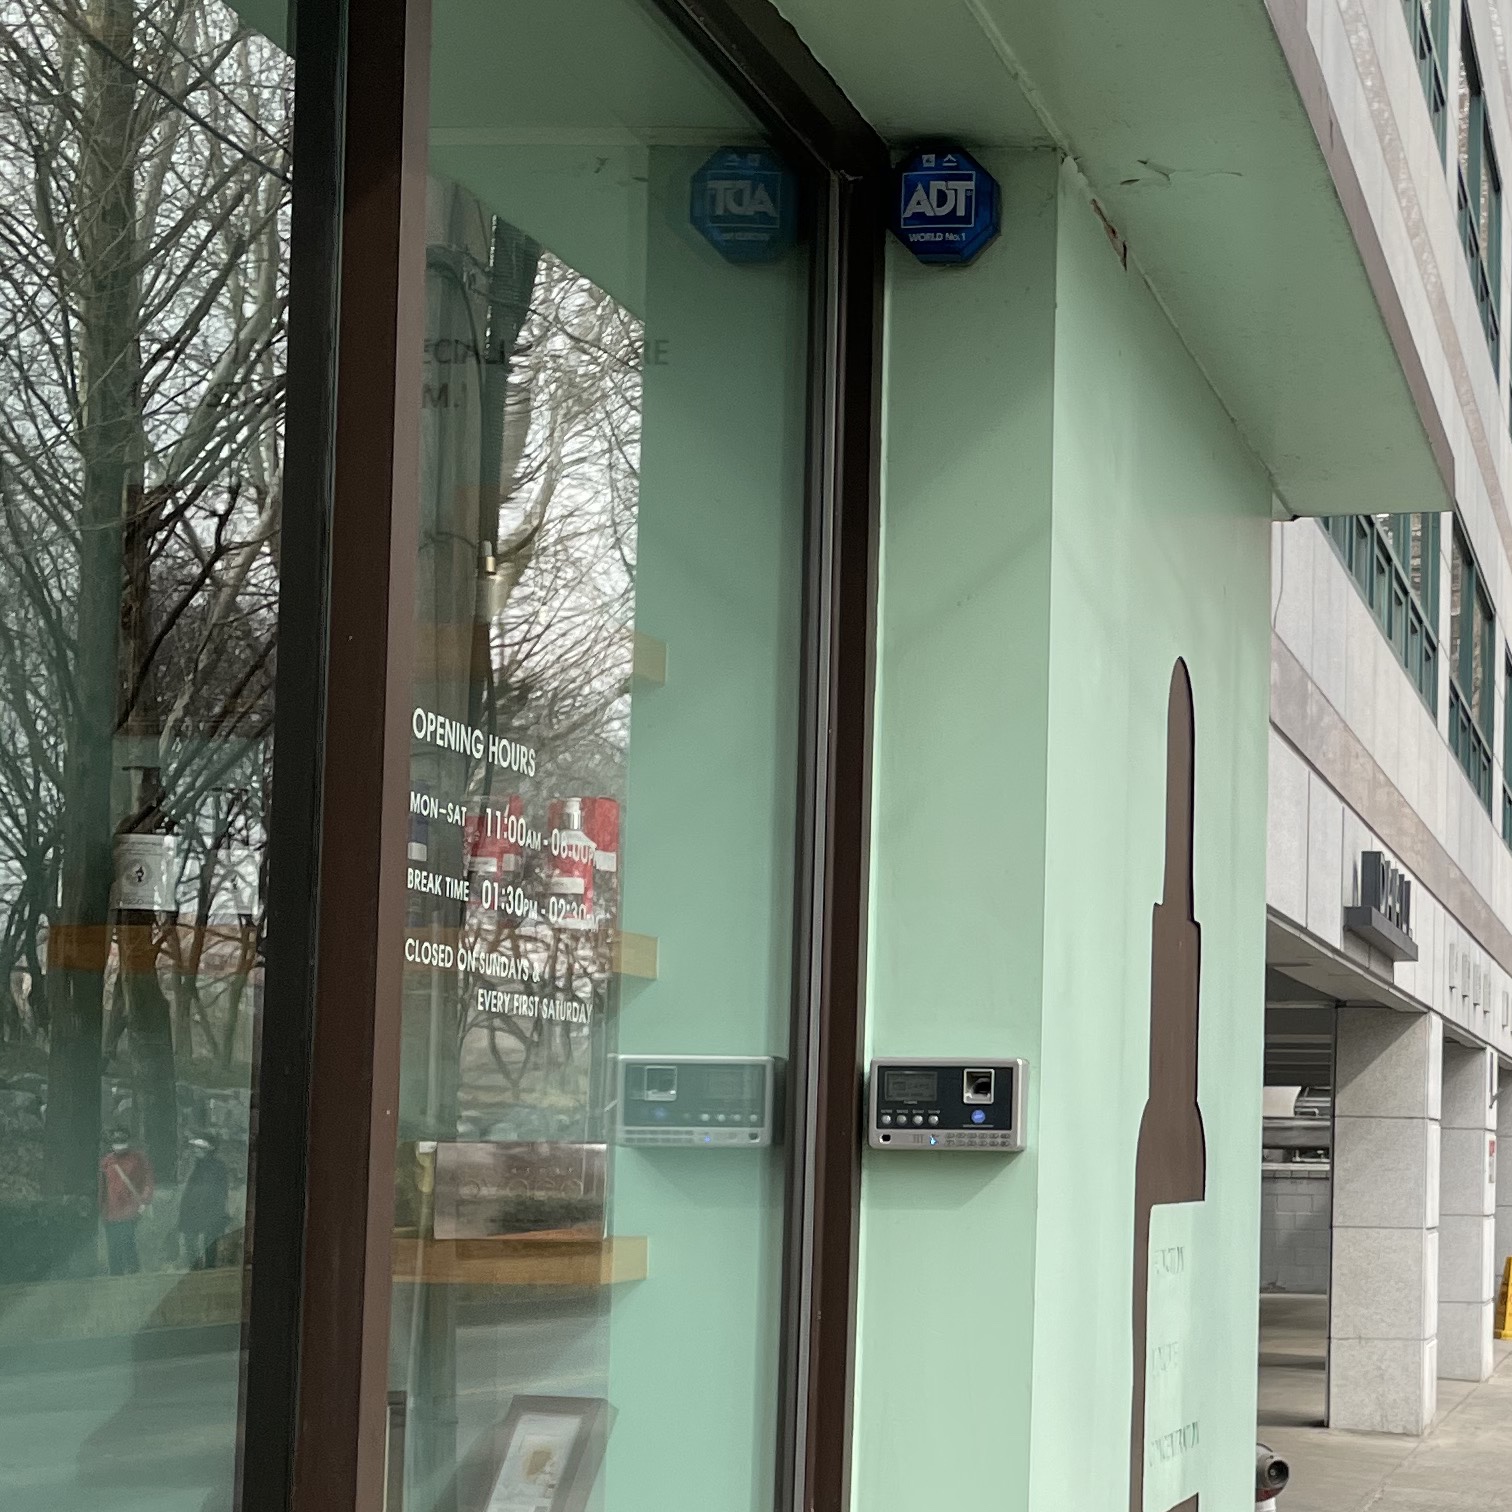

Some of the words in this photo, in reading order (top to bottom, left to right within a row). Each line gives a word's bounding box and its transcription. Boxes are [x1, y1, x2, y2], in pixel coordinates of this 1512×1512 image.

[902, 180, 975, 218] ADT
[908, 232, 944, 242] WORLD
[412, 707, 485, 759] OPENING
[488, 734, 536, 777] HOURS
[410, 791, 467, 827] MON-SAT
[407, 867, 442, 896] BREAK
[445, 876, 470, 902] TIME
[482, 879, 538, 920] 01:30PM
[405, 938, 454, 968] CLOSED
[457, 947, 476, 972] ON
[479, 952, 530, 982] SUNDAYS
[533, 962, 541, 982] &
[477, 989, 510, 1014] EVERY
[513, 993, 540, 1017] FIRST
[542, 998, 593, 1024] SATURDAY
